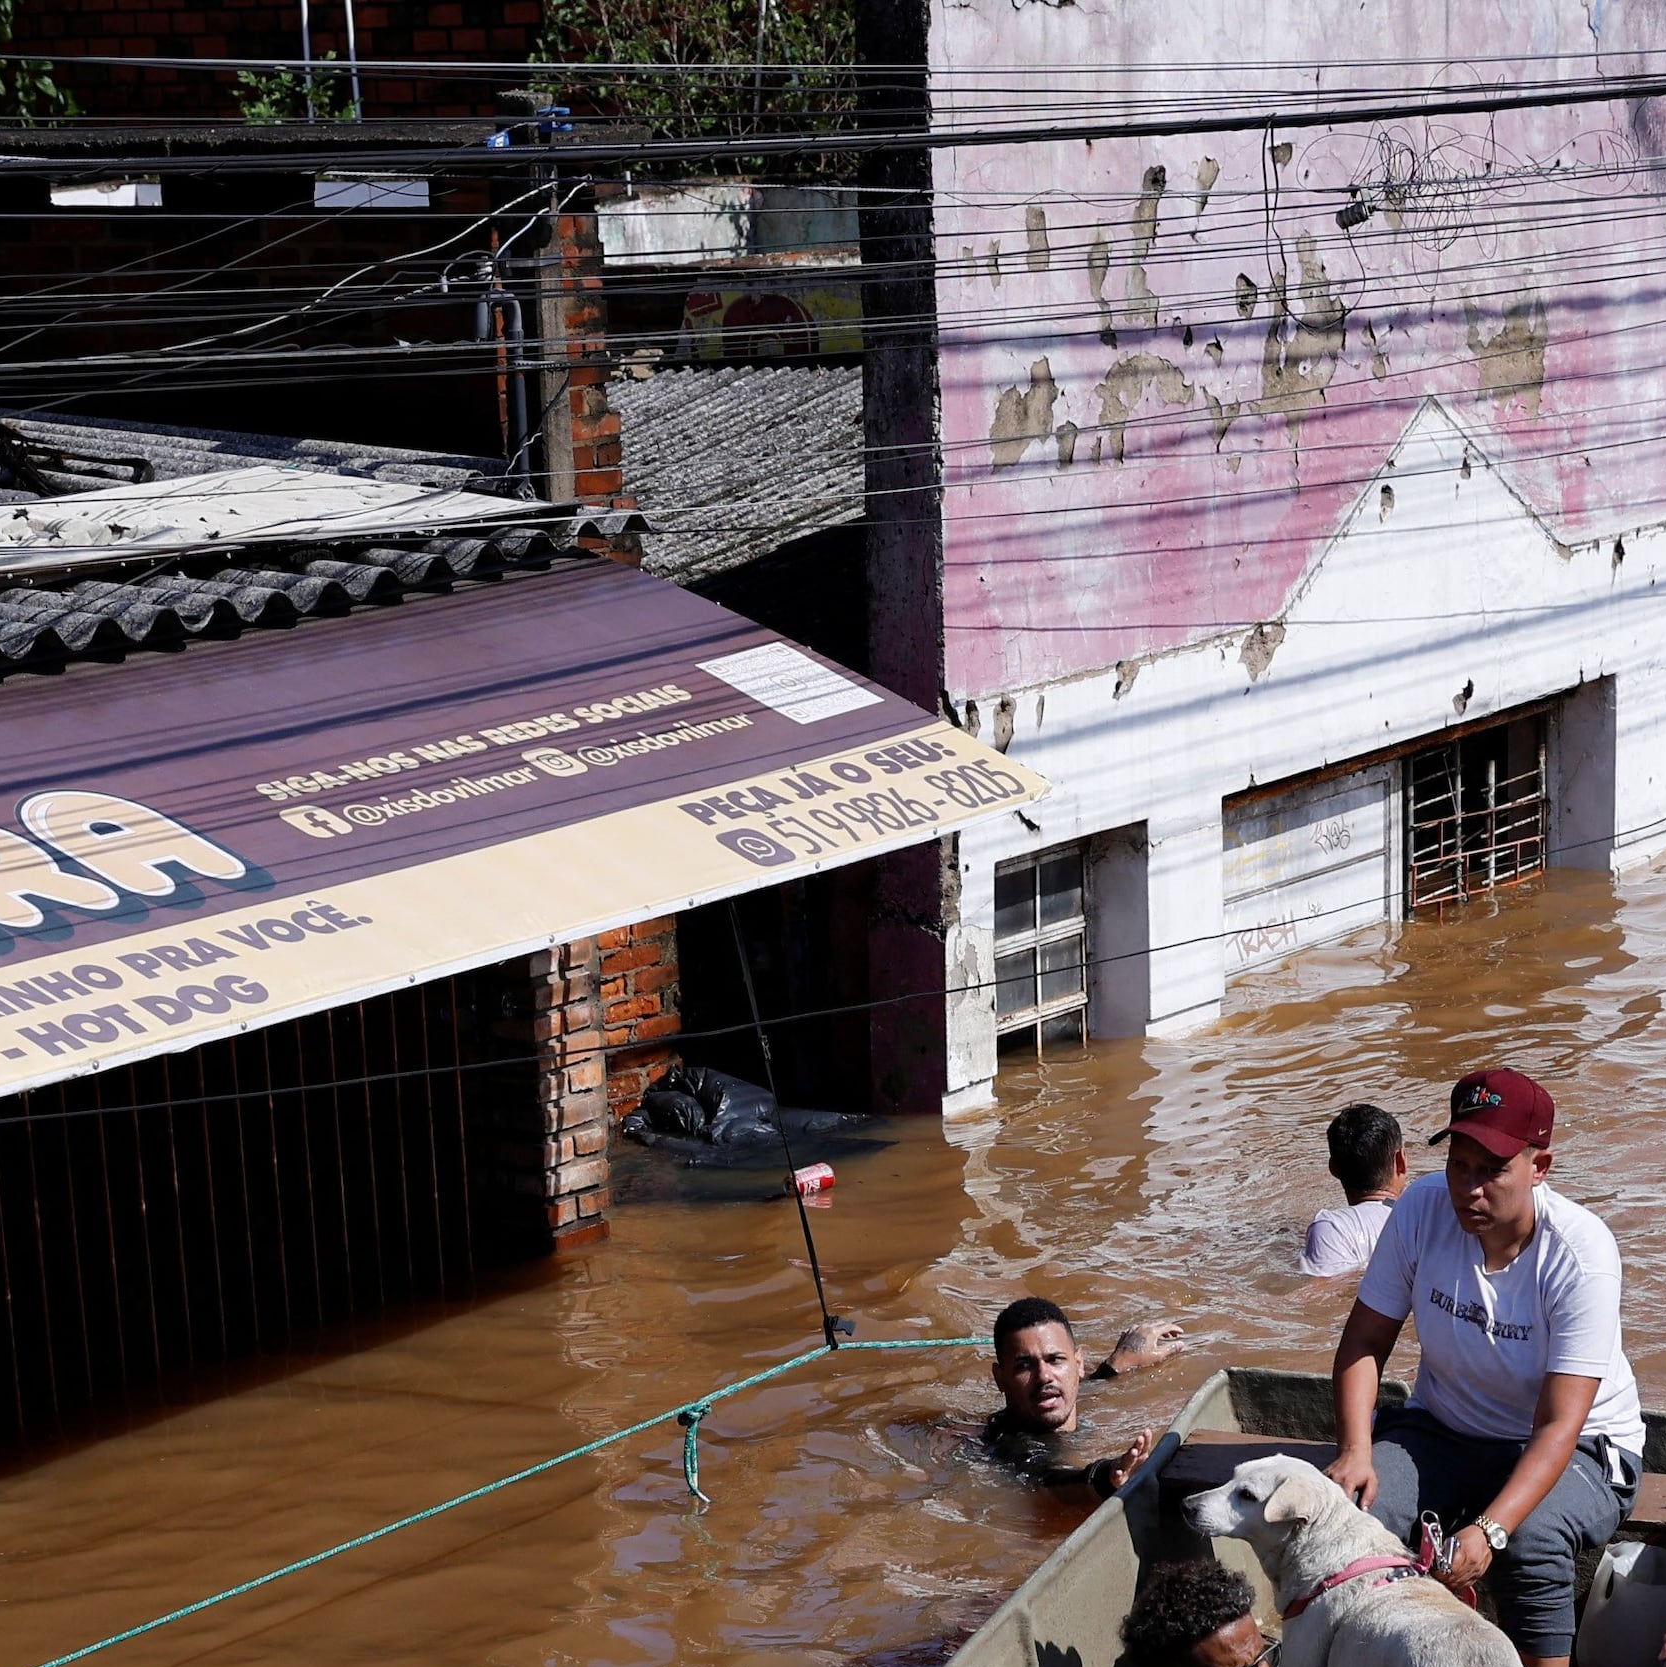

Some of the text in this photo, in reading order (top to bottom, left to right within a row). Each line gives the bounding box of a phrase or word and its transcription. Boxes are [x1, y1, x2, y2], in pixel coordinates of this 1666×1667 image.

[255, 684, 693, 802] SIGA-NOS NAS REDES SOCIAIS
[343, 766, 538, 826] @xisdovilmar
[578, 712, 754, 767] @xisdovilmar
[678, 738, 957, 825] PEÇA JÁ O SEU:
[766, 817, 840, 854] 51
[923, 759, 1025, 809] 8205
[116, 937, 239, 979] PRA
[218, 900, 374, 951] VOCÊ.
[16, 1004, 149, 1057] HOT
[132, 975, 269, 1027] DOG
[1464, 1086, 1502, 1106] ike
